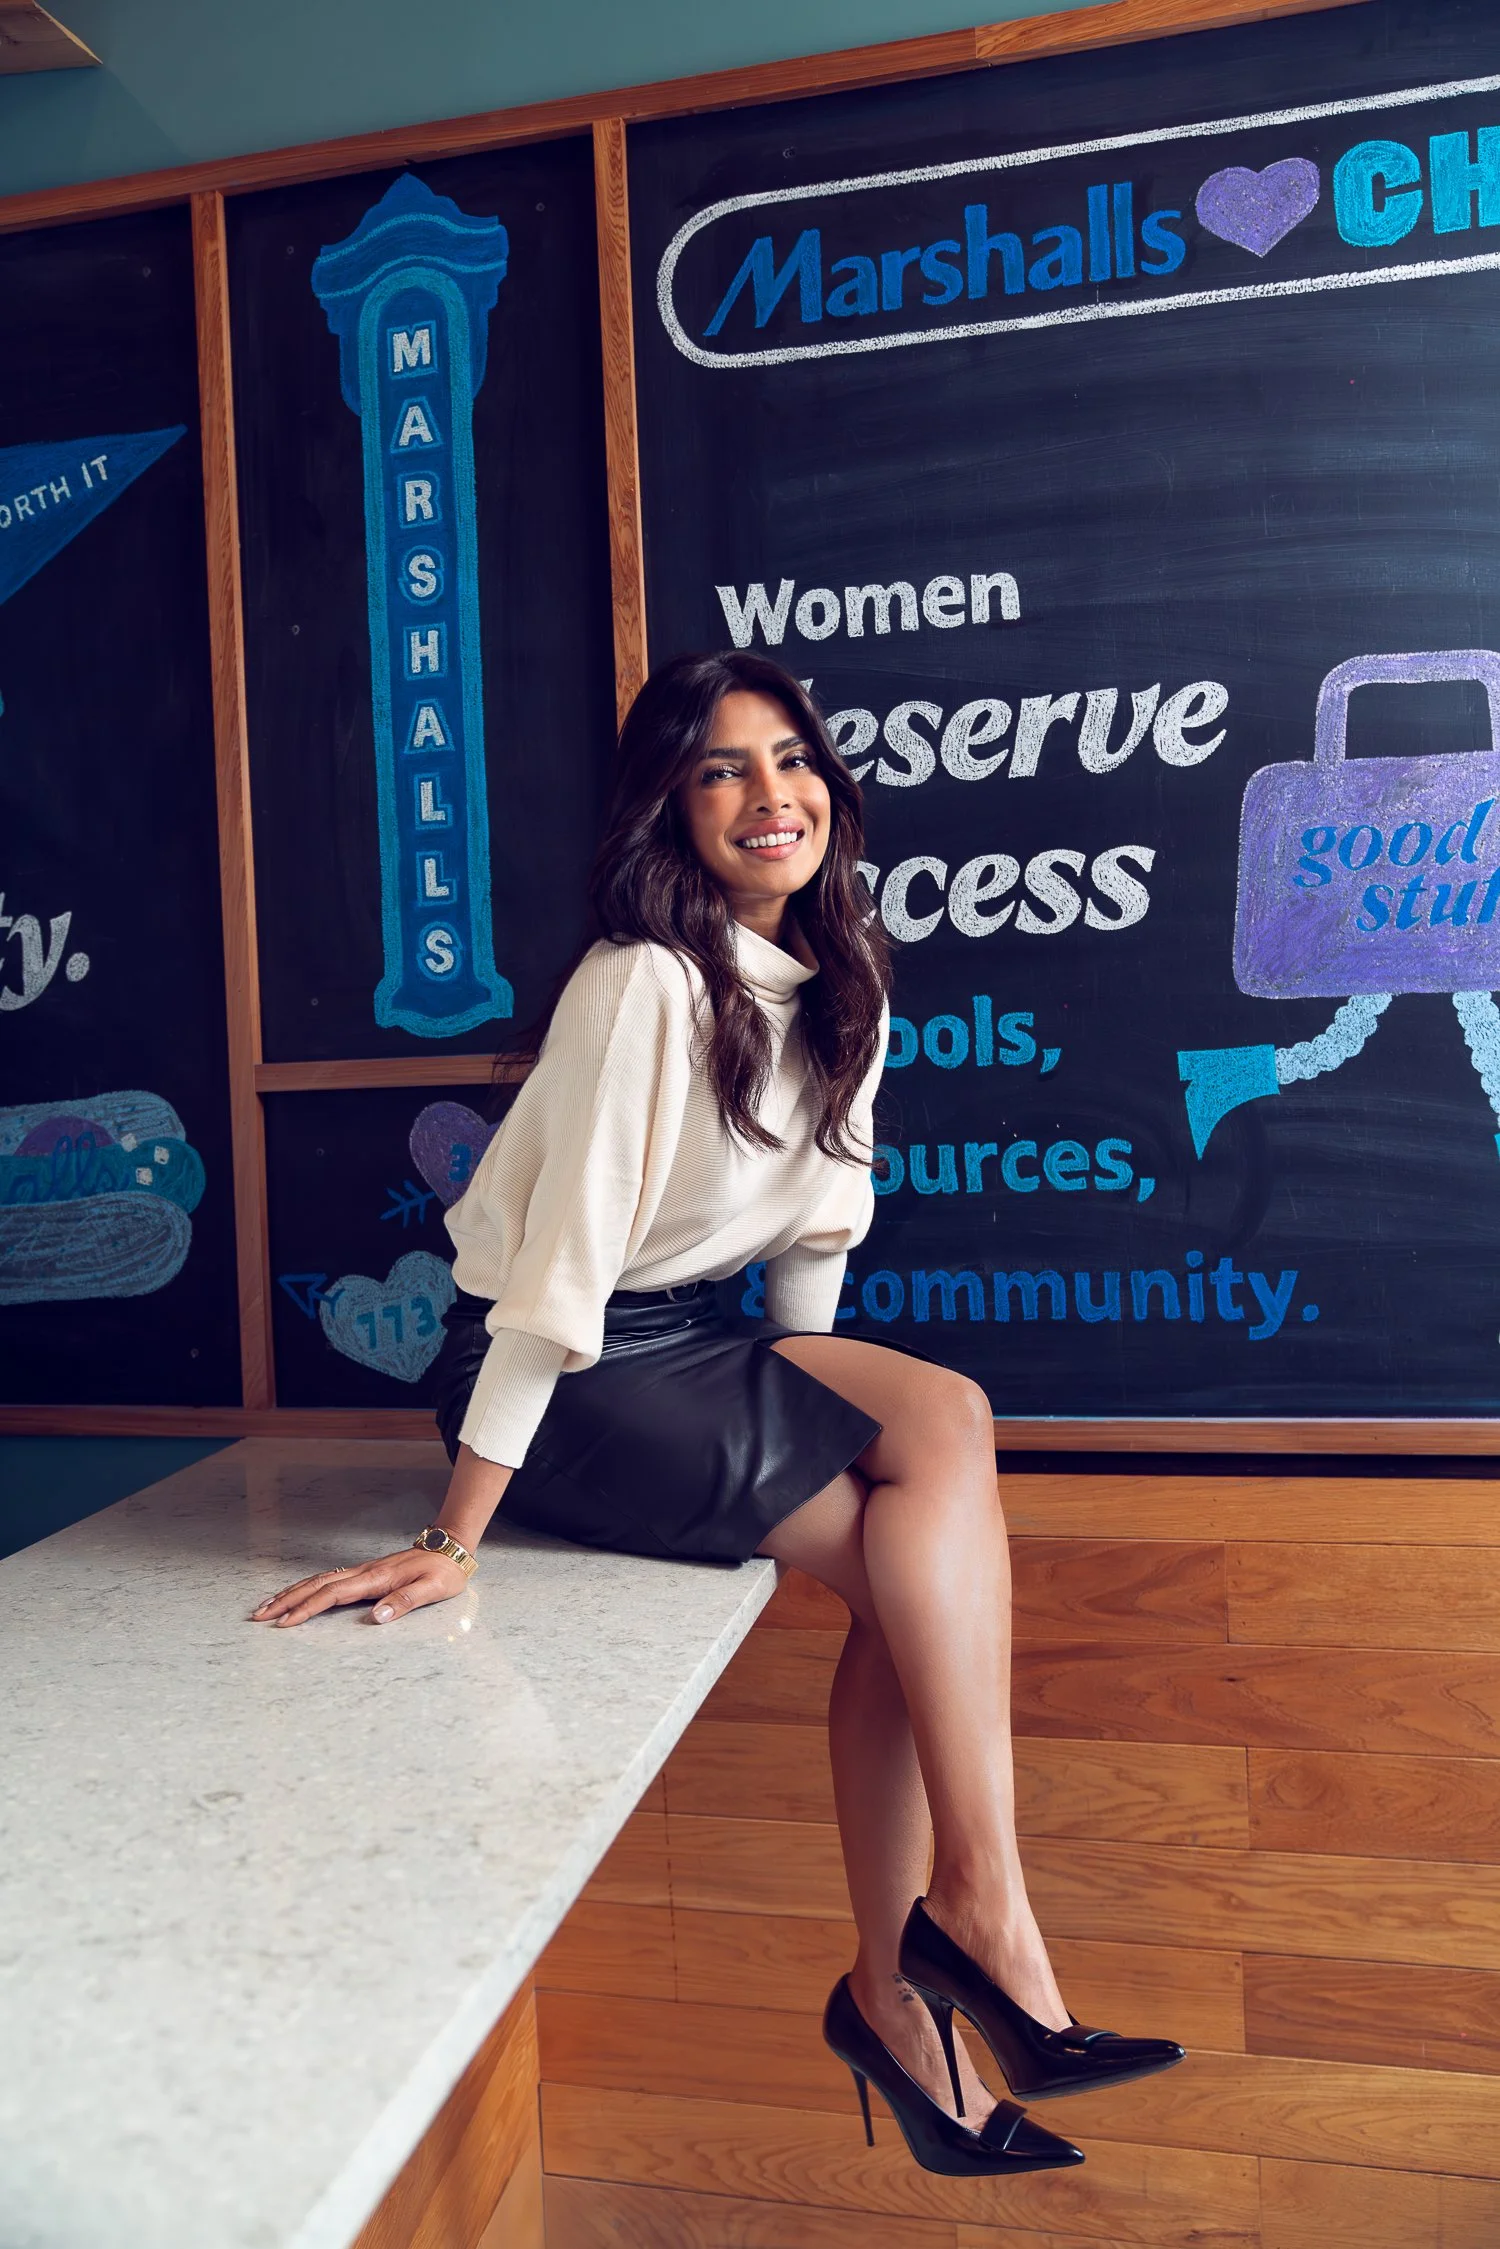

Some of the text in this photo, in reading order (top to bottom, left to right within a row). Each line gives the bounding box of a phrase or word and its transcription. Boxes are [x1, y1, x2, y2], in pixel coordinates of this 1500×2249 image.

[702, 125, 1500, 336] Marshalls CH
[81, 454, 108, 489] IT
[392, 330, 456, 975] MARSHALLS
[715, 572, 1021, 648] Women
[801, 678, 1229, 787] eserve
[855, 845, 1156, 942] cess
[1292, 797, 1495, 888] good
[0, 891, 91, 1012] y.
